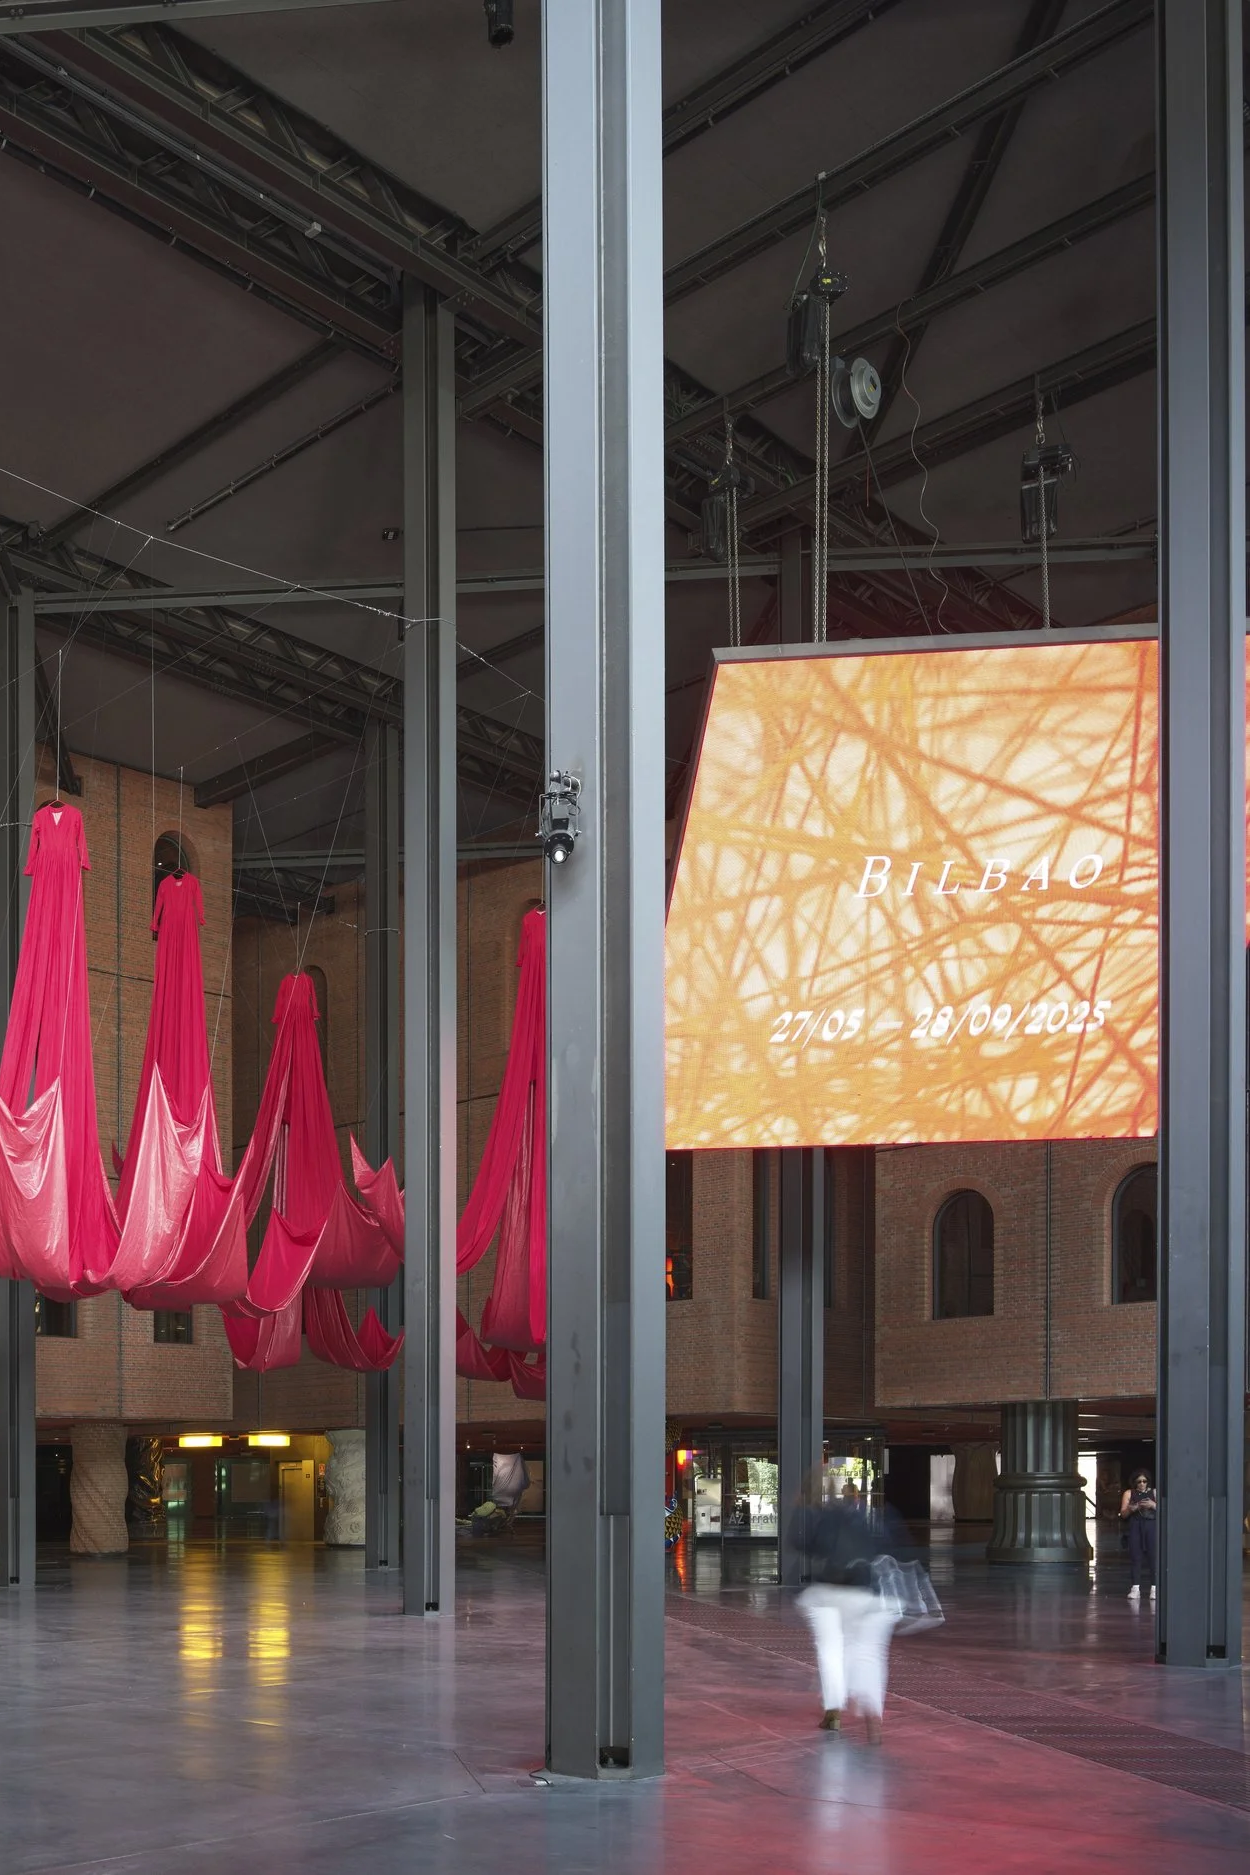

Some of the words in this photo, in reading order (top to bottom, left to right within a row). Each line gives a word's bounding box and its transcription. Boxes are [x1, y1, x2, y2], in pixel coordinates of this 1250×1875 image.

[854, 854, 1103, 898] BILBAO
[769, 1008, 865, 1050] 27/05
[910, 1000, 1112, 1046] 28/09/2025
[729, 1512, 745, 1525] AZ
